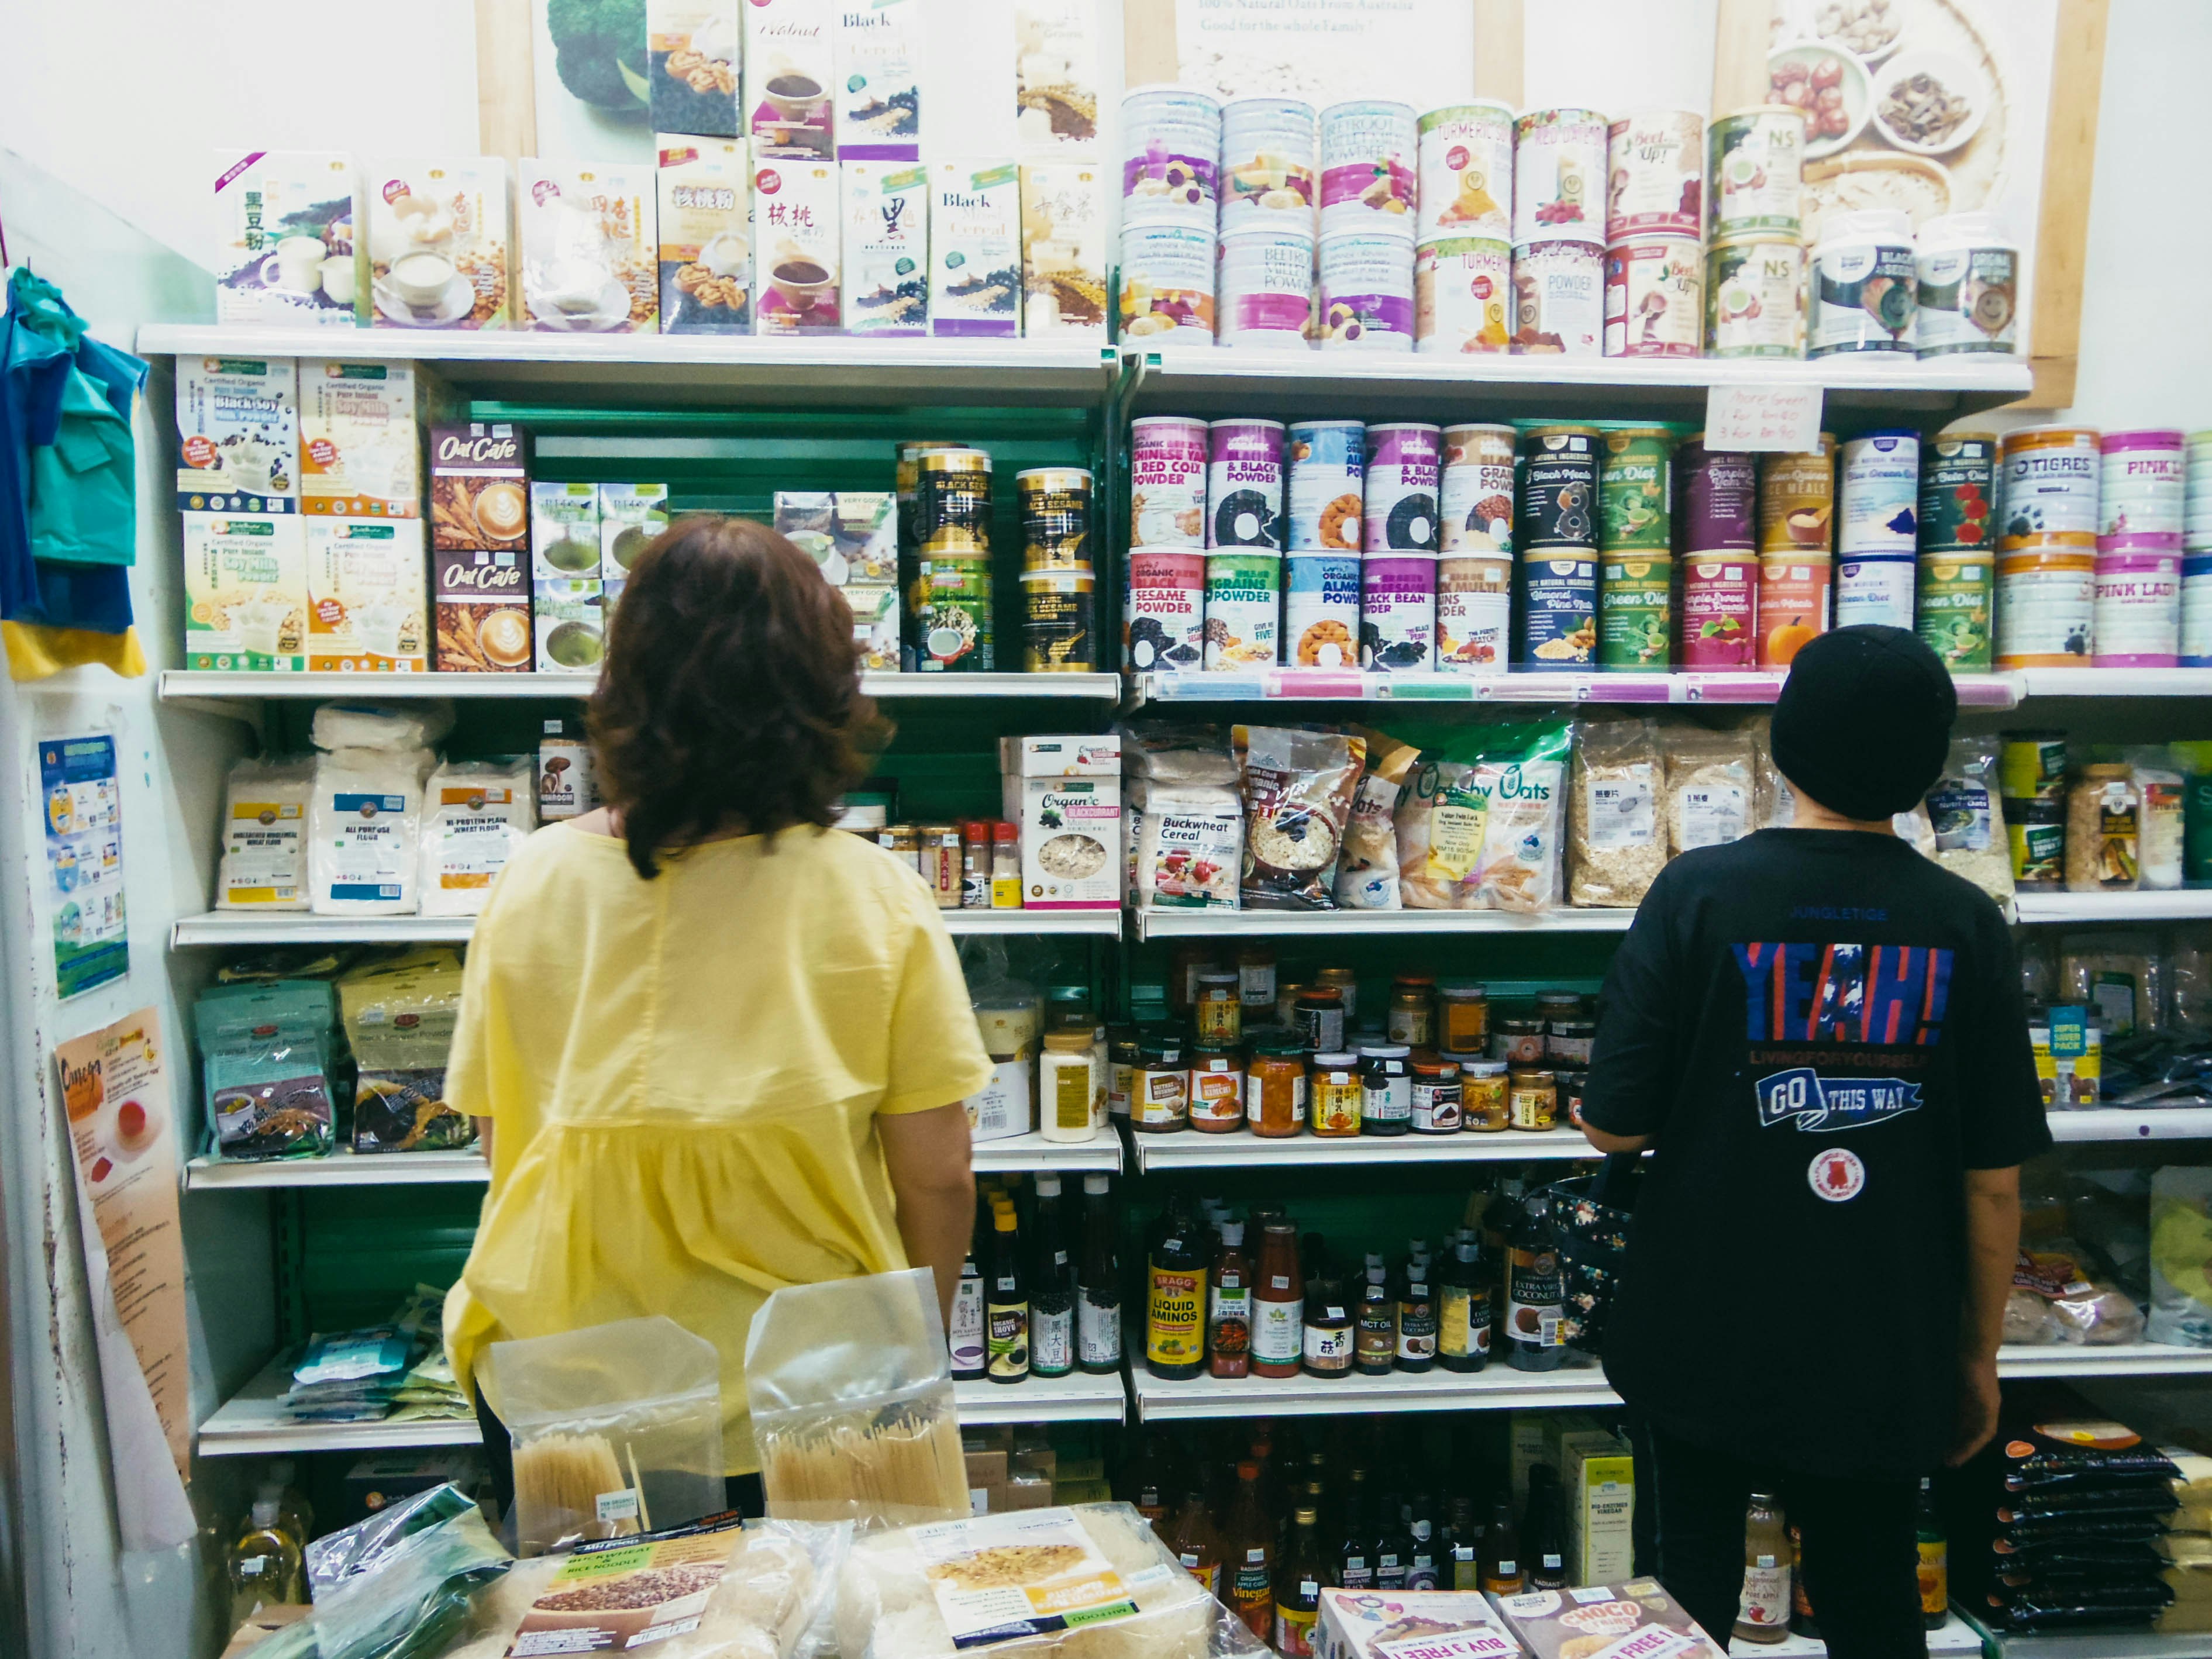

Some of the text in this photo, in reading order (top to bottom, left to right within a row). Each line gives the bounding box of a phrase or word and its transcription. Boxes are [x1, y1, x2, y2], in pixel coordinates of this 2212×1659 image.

[843, 13, 891, 27] Black
[673, 185, 735, 211] 核桃粉
[943, 193, 991, 208] Black
[245, 191, 264, 251] 黑豆粉
[769, 203, 814, 227] 核桃
[950, 222, 1005, 236] Cereal
[1548, 275, 1593, 290] POWDER
[238, 380, 266, 388] Organic
[336, 391, 378, 400] Pure Instant
[215, 396, 276, 413] Black Soy
[1733, 409, 1751, 420] for
[1732, 426, 1751, 437] for
[1142, 462, 1201, 474] RED COIX
[1228, 463, 1276, 473] & BLACK
[1401, 465, 1411, 475] &
[1624, 467, 1656, 480] Diet
[2127, 461, 2170, 474] PINK
[1133, 474, 1185, 485] POWDER
[1227, 473, 1276, 483] POWDER
[936, 481, 967, 489] BLACK
[1048, 501, 1084, 509] SESAME
[223, 557, 278, 572] Soy Milk
[1136, 569, 1174, 577] ORGANIC
[1212, 578, 1266, 590] GRAINS
[1136, 590, 1186, 602] SESAME
[1214, 591, 1270, 603] POWDER
[1530, 589, 1572, 601] Almond
[2096, 584, 2135, 598] PINK
[1395, 594, 1425, 603] BEAN
[1546, 599, 1573, 610] Pine
[1603, 592, 1641, 608] Green
[1952, 594, 1984, 607] Diet
[1039, 603, 1077, 613] SESAME
[1136, 602, 1192, 613] POWDER
[1254, 622, 1267, 631] GIVE
[1500, 764, 1549, 800] Oats
[1042, 794, 1100, 809] Organic
[1069, 808, 1119, 817] BLACKCURRANT
[358, 826, 390, 834] PURPOSE
[1162, 818, 1229, 832] Buckwheat
[1161, 829, 1200, 840] Cereal
[1732, 942, 1955, 1046] YEAH!
[419, 1029, 453, 1038] Powder
[2053, 1024, 2080, 1032] SUPER
[2054, 1042, 2080, 1050] PACK
[1205, 1086, 1231, 1096] KIMCHI
[1770, 1076, 1906, 1116] GO THIS WAY
[1156, 1277, 1192, 1286] BRAGG
[1515, 1281, 1539, 1289] EXTRA
[1512, 1288, 1556, 1299] COCONUT
[1151, 1309, 1198, 1322] AMINOS
[994, 1325, 1016, 1333] SHOYU
[1360, 1319, 1392, 1328] MCT OIL
[1051, 1320, 1062, 1360] 黑大豆
[568, 1547, 651, 1564] BUCKWHEAT
[594, 1558, 639, 1570] NOODLE
[1534, 1579, 1561, 1588] RADIANT
[1232, 1586, 1271, 1600] Vinegar
[1762, 1592, 1779, 1600] APPLE
[1072, 1611, 1107, 1623] FOOD
[1563, 1603, 1638, 1623] CHOCO
[1467, 1637, 1507, 1653] BUY
[1620, 1635, 1666, 1658] FREE
